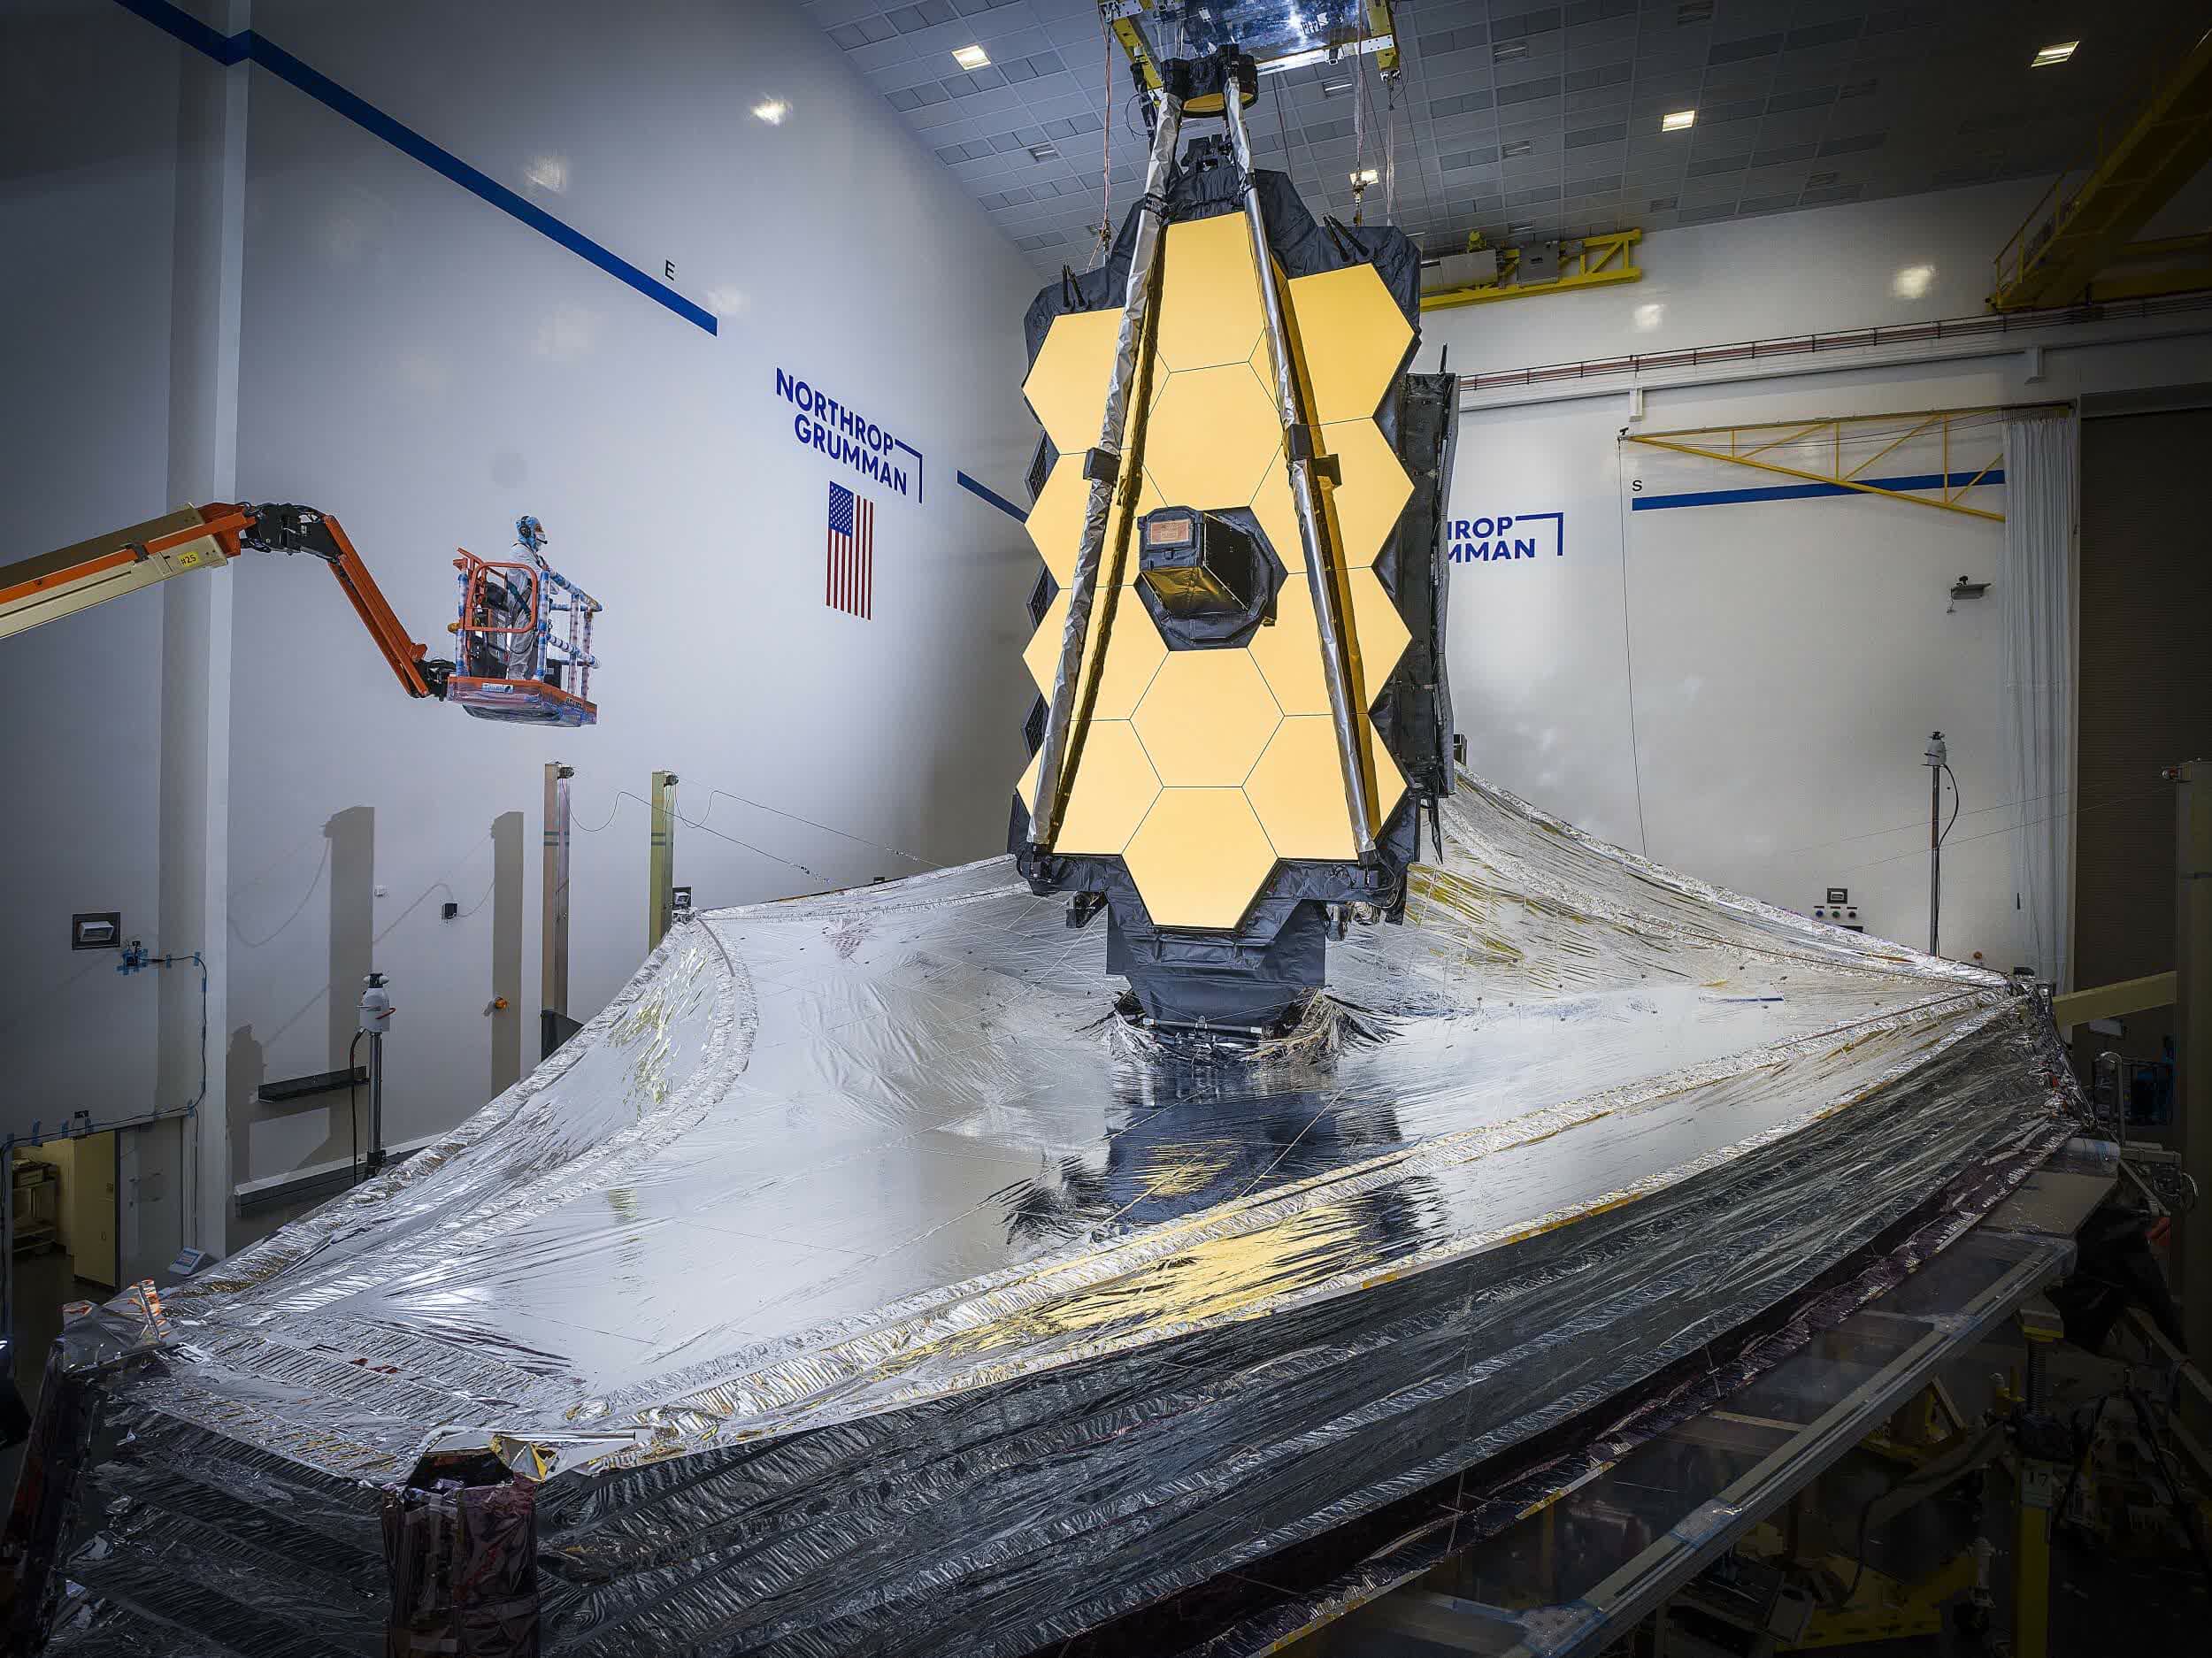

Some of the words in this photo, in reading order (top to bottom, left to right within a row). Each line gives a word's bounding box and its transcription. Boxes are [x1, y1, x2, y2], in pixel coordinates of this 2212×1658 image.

[665, 260, 675, 280] E
[776, 367, 894, 456] NORTHROP
[795, 413, 907, 496] GRUMMAN
[1632, 480, 1642, 492] S
